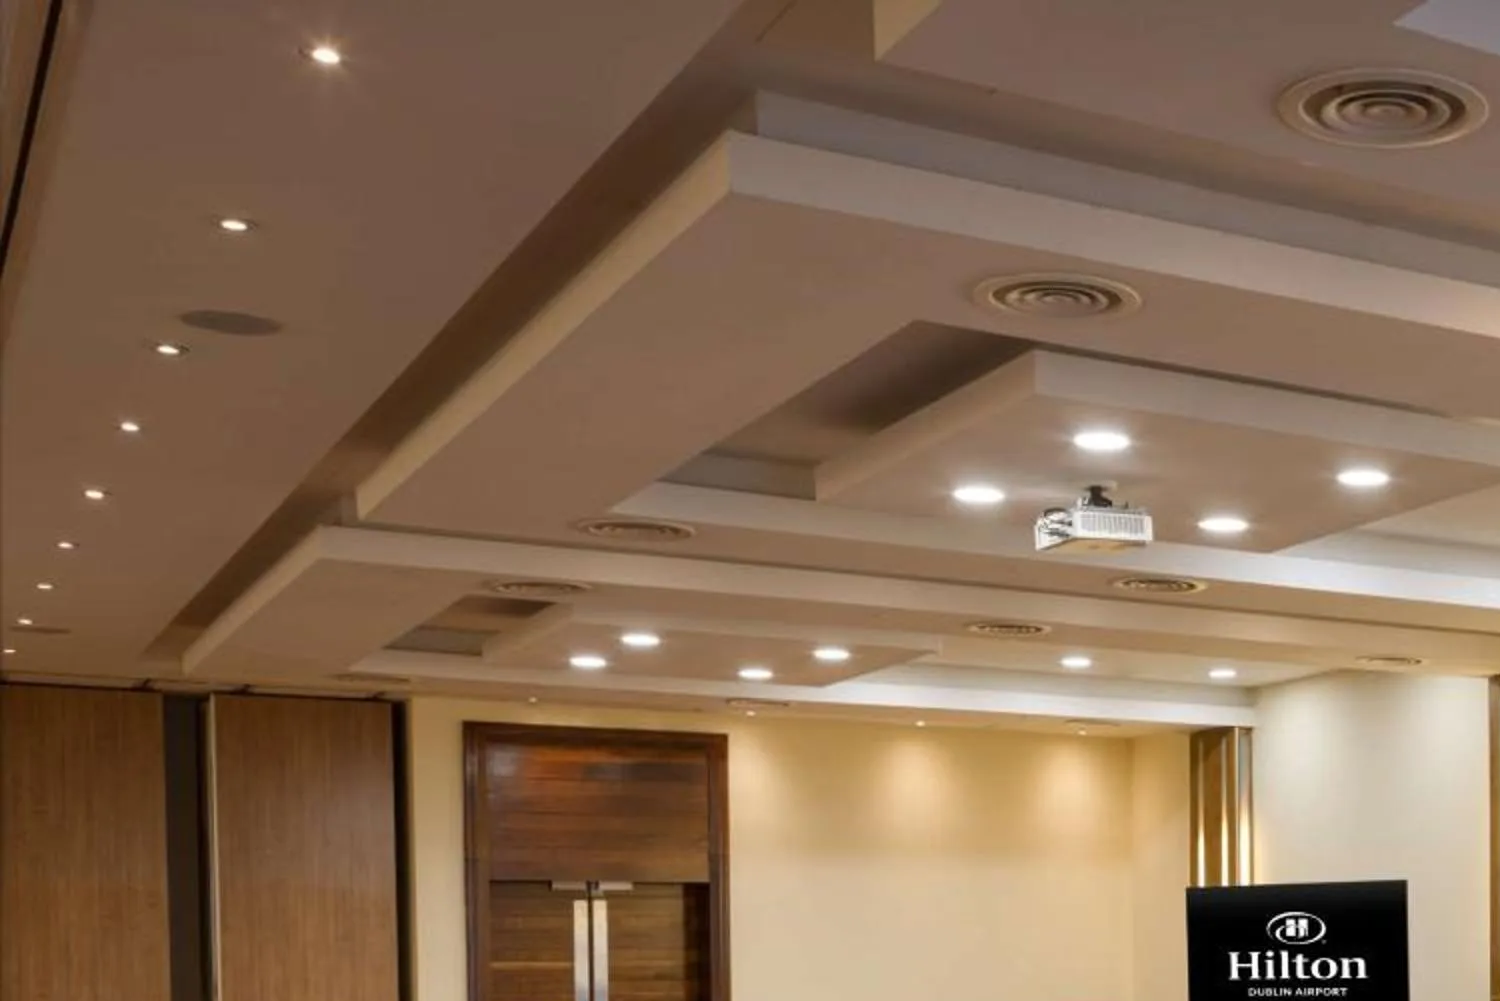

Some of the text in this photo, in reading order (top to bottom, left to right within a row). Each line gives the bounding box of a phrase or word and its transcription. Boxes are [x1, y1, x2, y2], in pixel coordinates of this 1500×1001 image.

[1228, 950, 1368, 980] Hilton
[1248, 987, 1348, 997] DUBLIN AIRPORT
